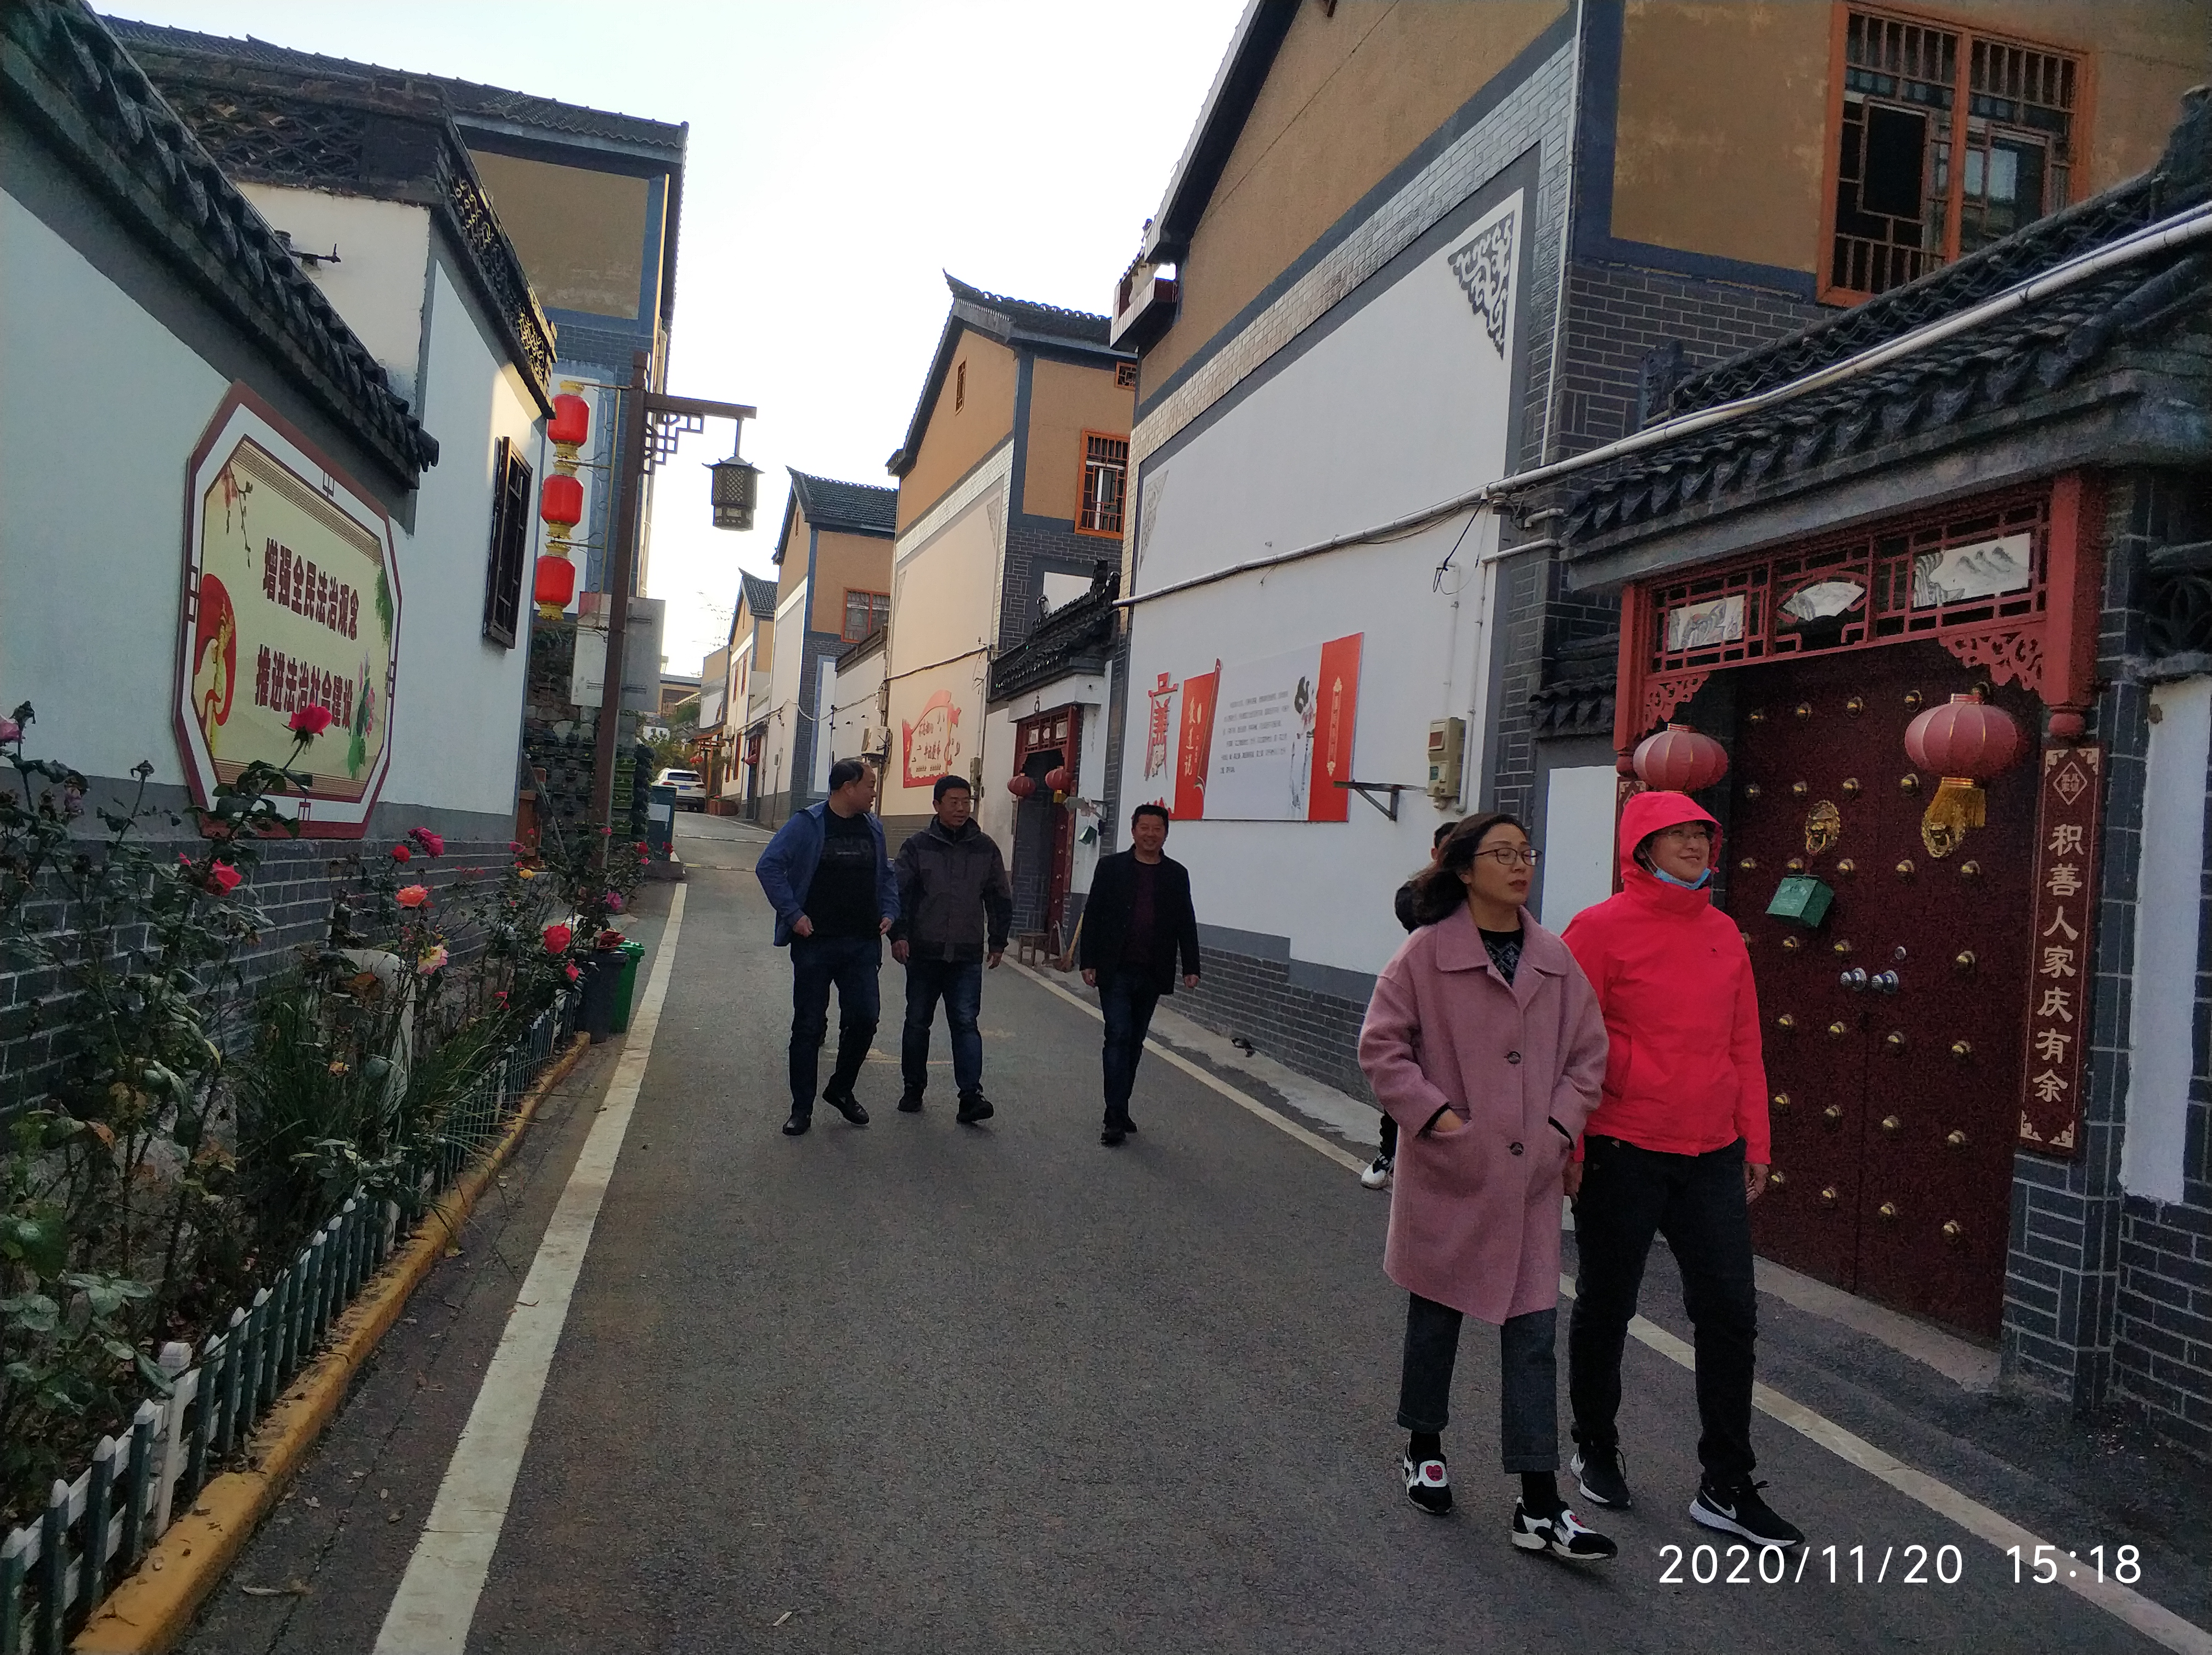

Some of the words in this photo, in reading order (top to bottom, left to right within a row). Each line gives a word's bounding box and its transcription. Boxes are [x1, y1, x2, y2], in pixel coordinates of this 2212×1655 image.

[263, 537, 359, 641] 增强全民法治观念
[255, 644, 353, 730] 推进法治社会建设
[2033, 824, 2084, 1102] 积善人家庆有余
